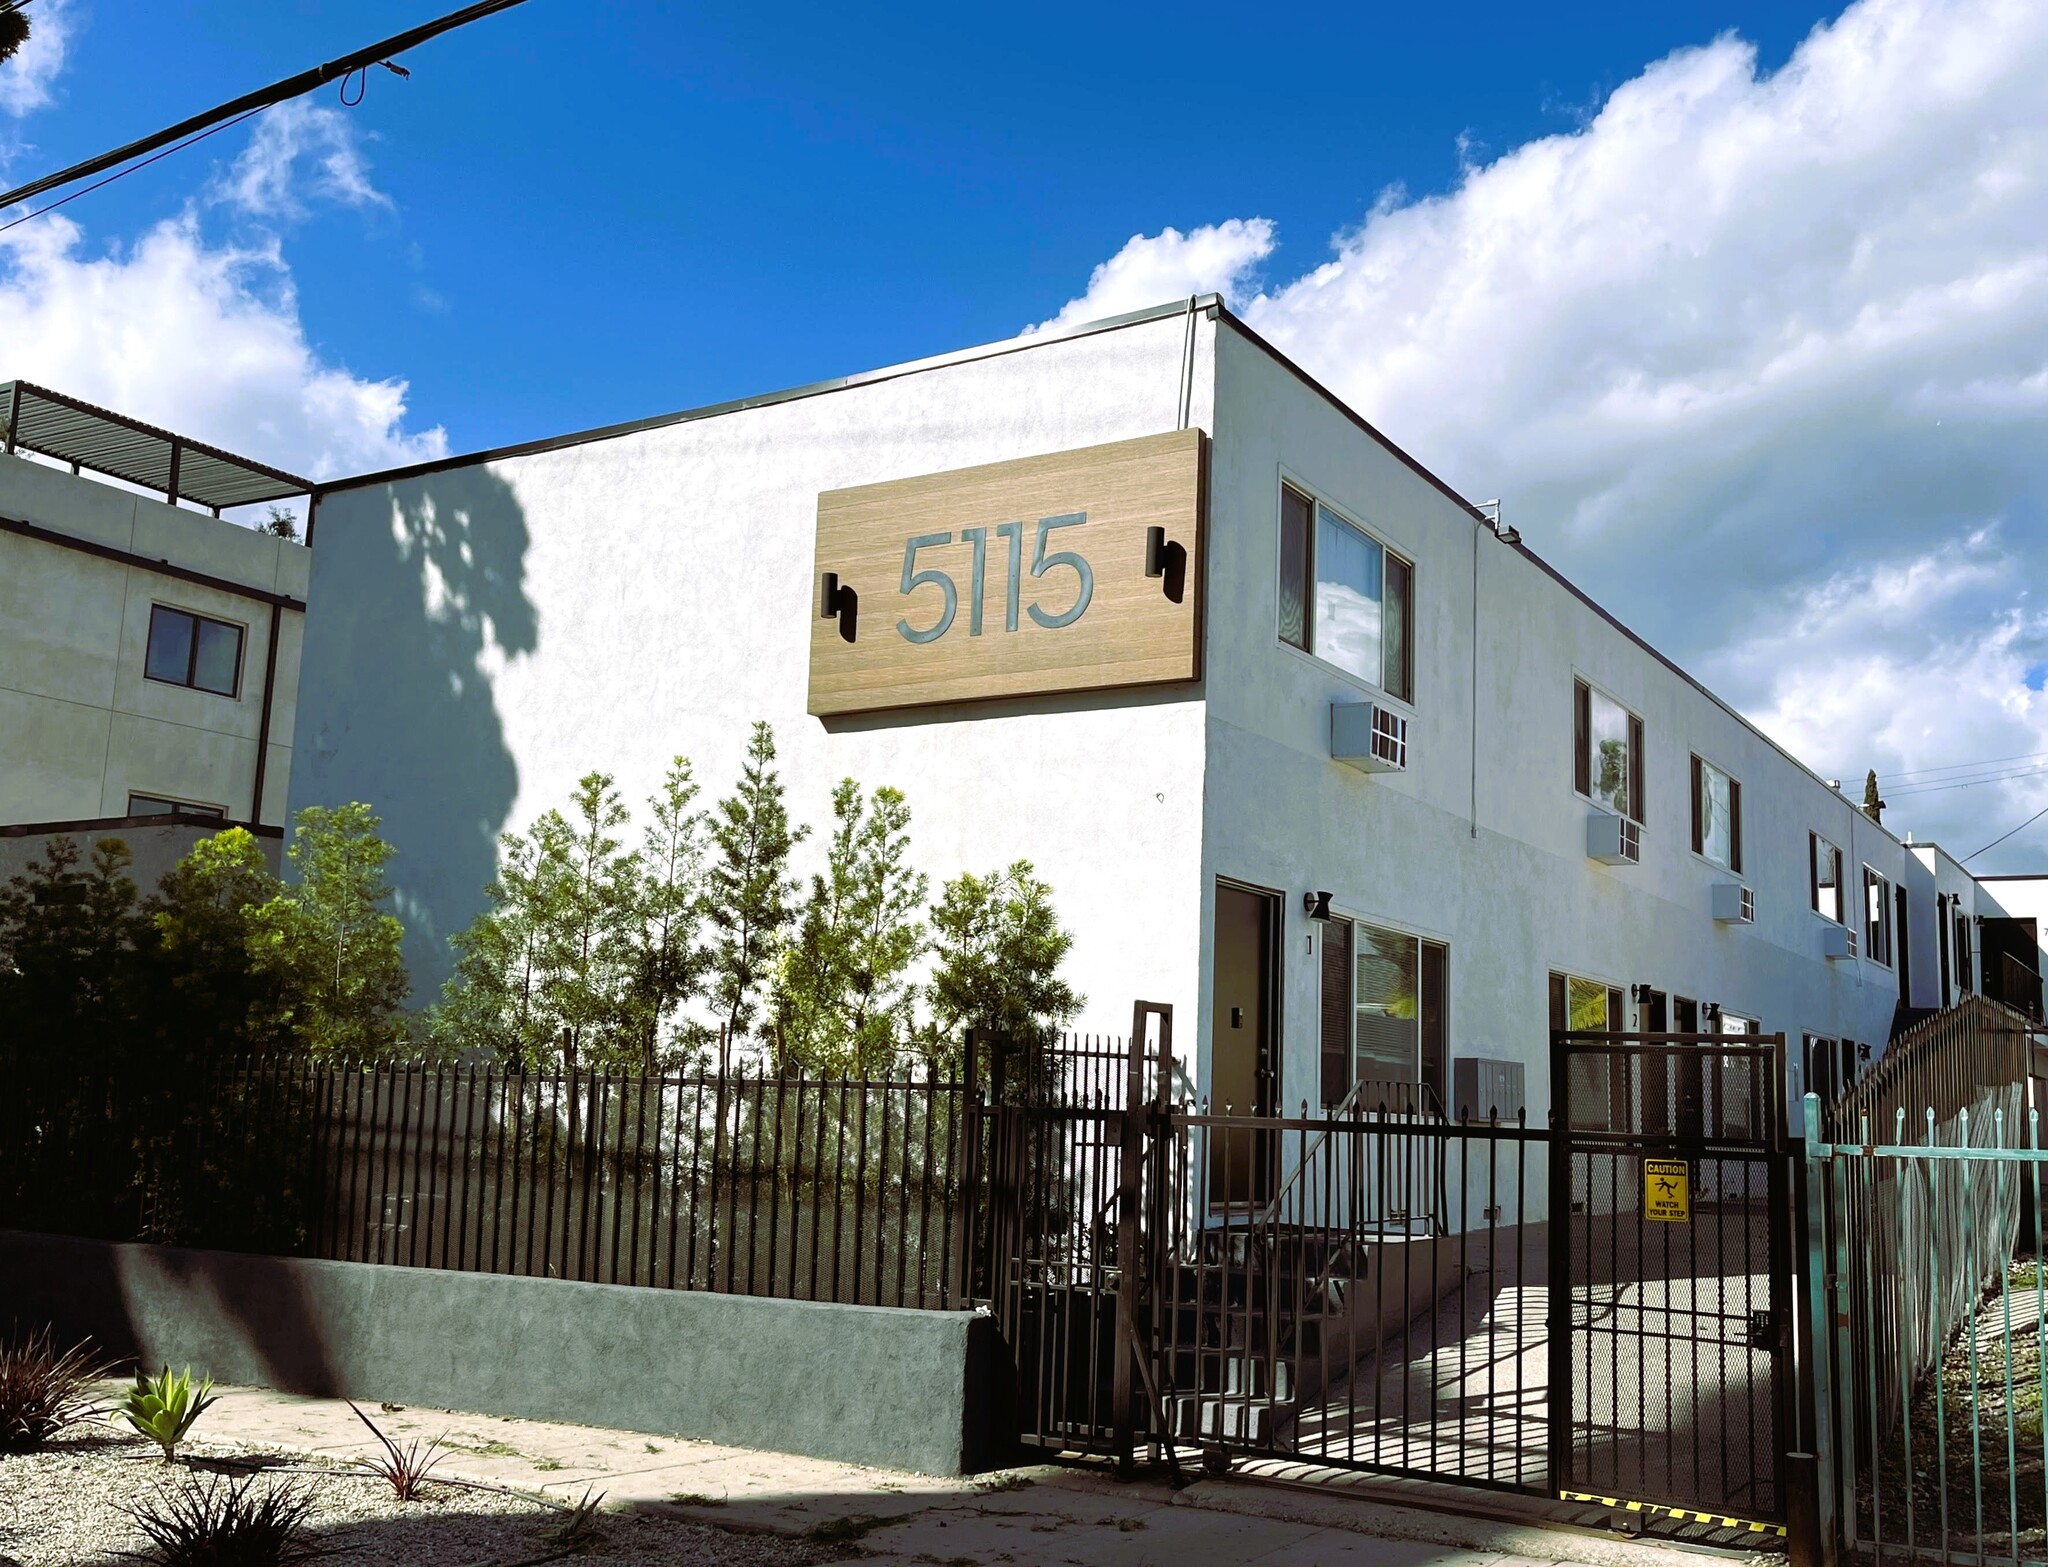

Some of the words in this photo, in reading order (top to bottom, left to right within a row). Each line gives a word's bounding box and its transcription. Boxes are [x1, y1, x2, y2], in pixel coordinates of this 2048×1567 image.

[896, 512, 1093, 643] 5115
[1306, 935, 1312, 955] 1
[1632, 1013, 1637, 1027] 2
[1648, 1164, 1685, 1174] CAUTION
